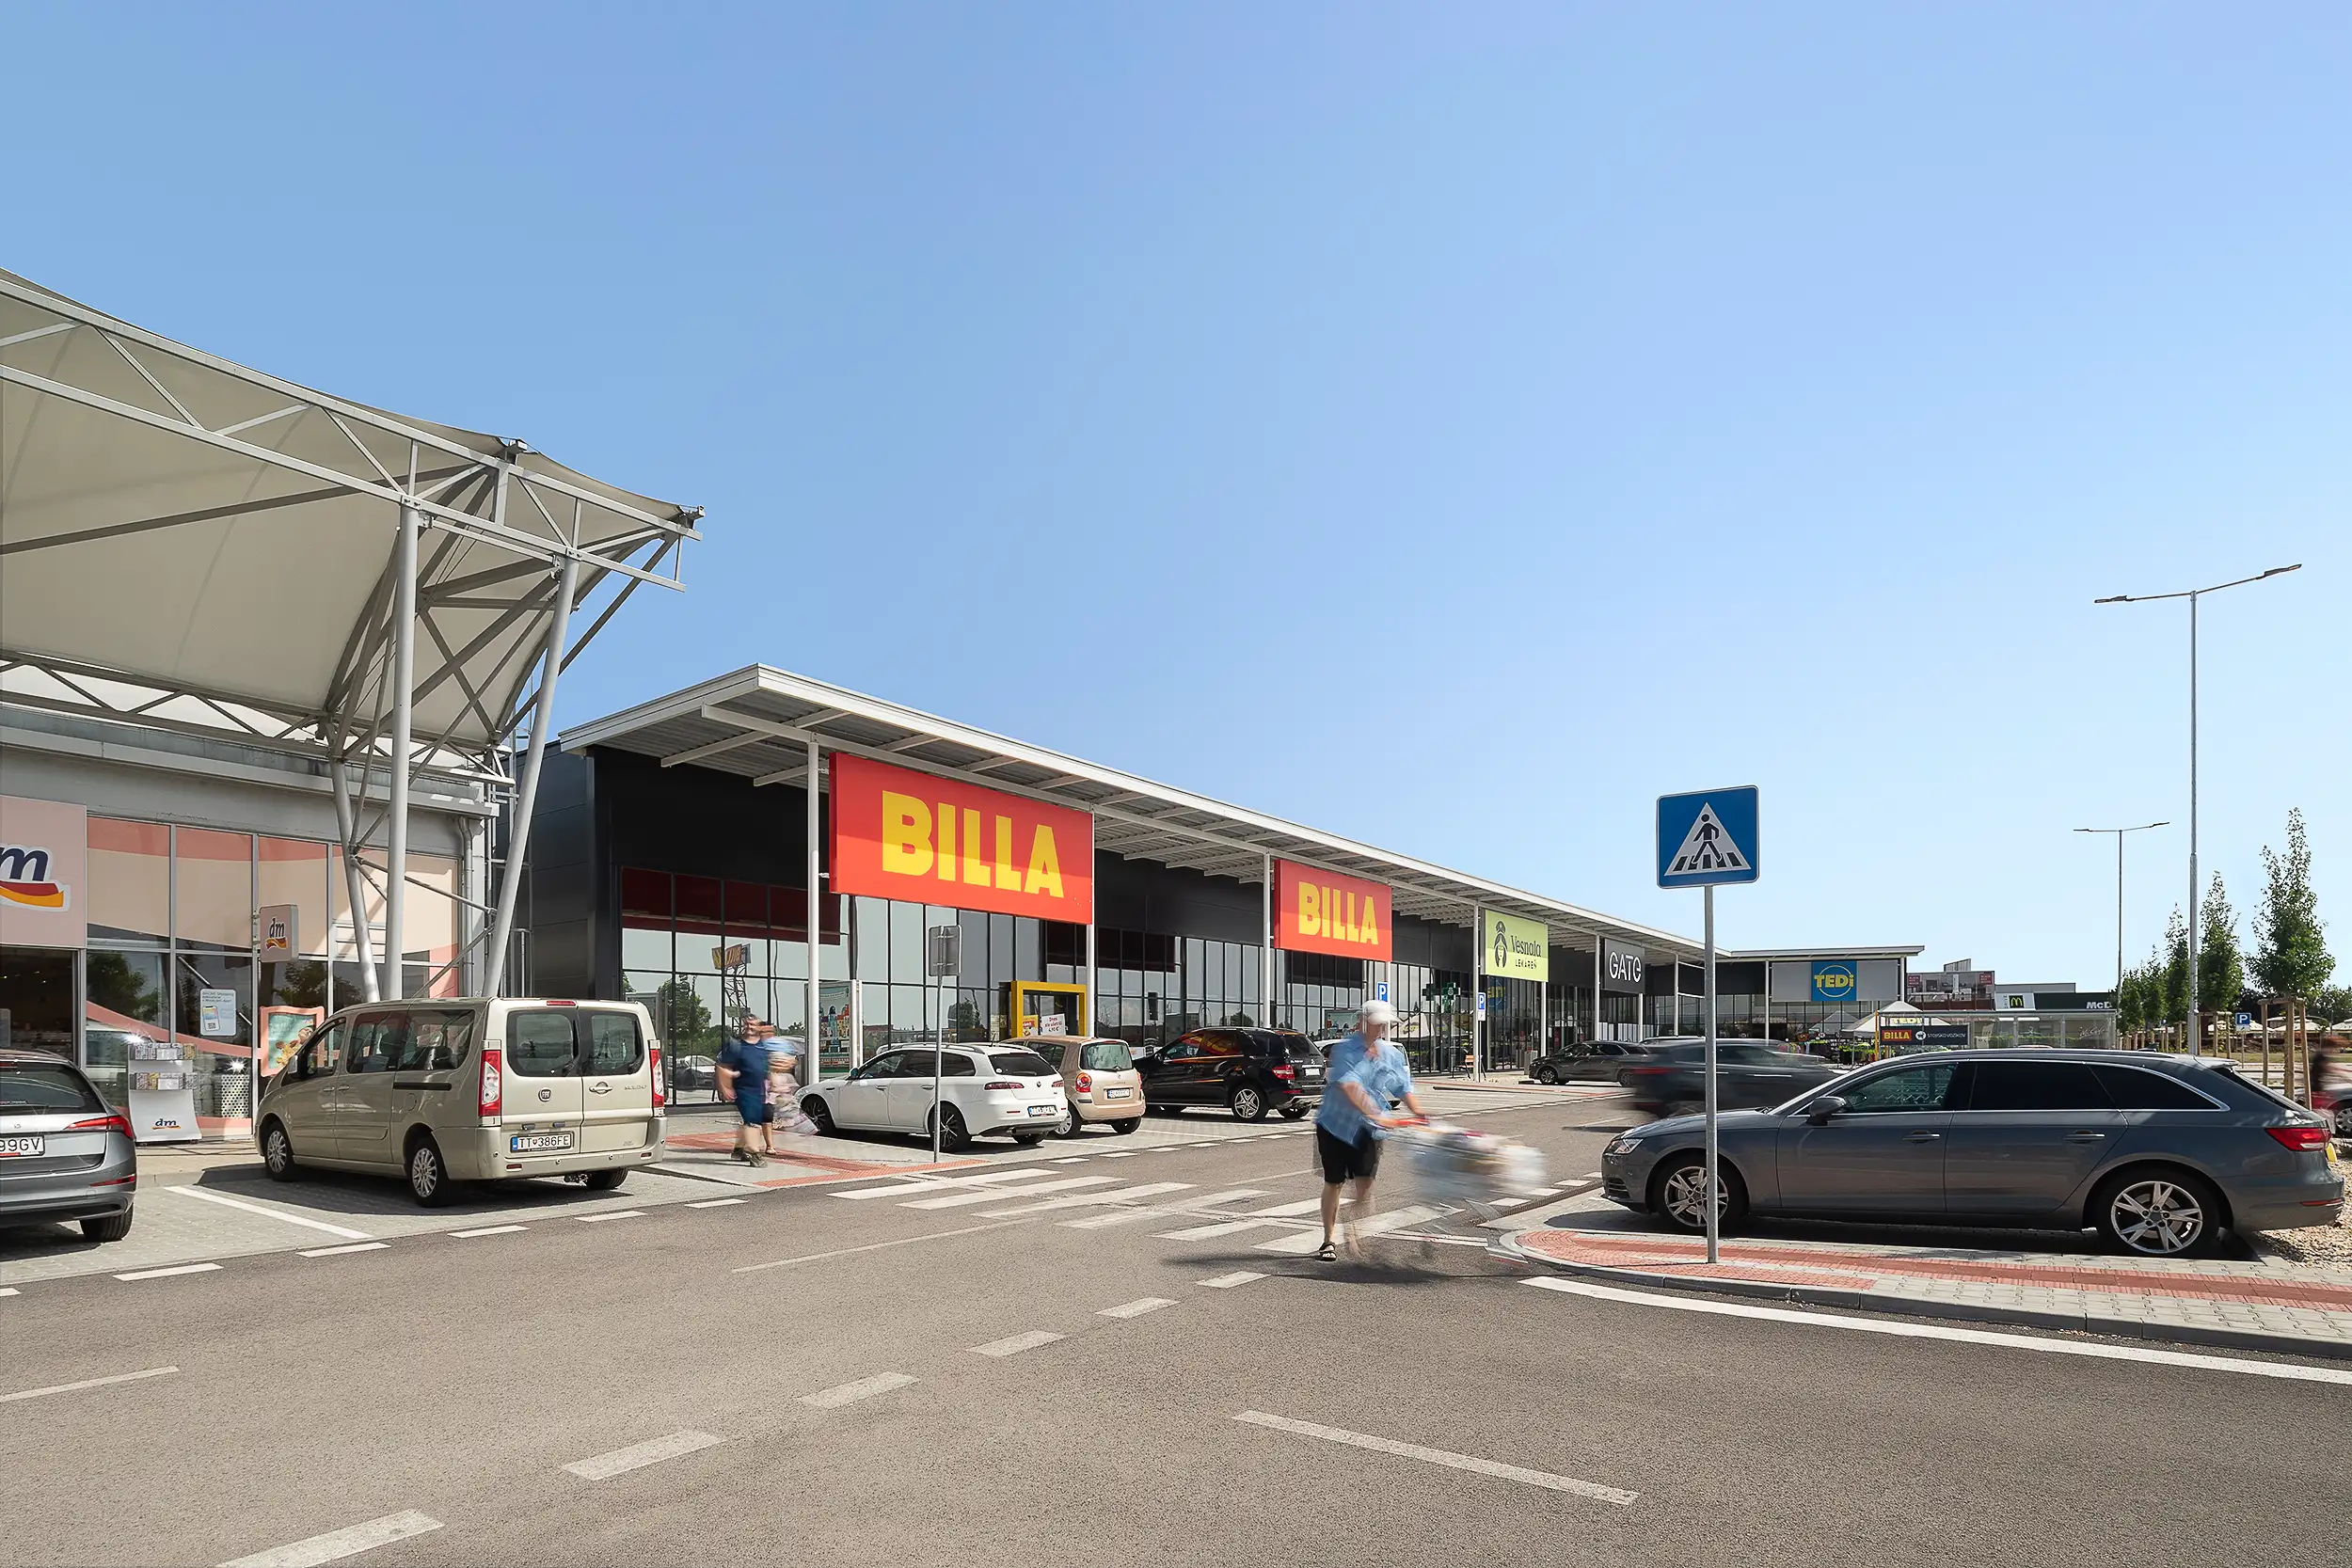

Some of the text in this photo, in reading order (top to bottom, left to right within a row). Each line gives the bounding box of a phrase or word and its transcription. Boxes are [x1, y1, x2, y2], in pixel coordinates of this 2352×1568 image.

[882, 790, 1064, 898] BILLA
[1298, 881, 1378, 945] BILLA
[269, 917, 285, 939] dm
[1511, 935, 1541, 958] Vesnala
[1814, 974, 1854, 988] TEDi
[1379, 984, 1387, 1001] P
[1479, 994, 1485, 1006] P
[2239, 1014, 2249, 1024] P
[1883, 1031, 1910, 1039] BILLA
[155, 1117, 177, 1127] dm
[537, 1135, 569, 1147] 386FE
